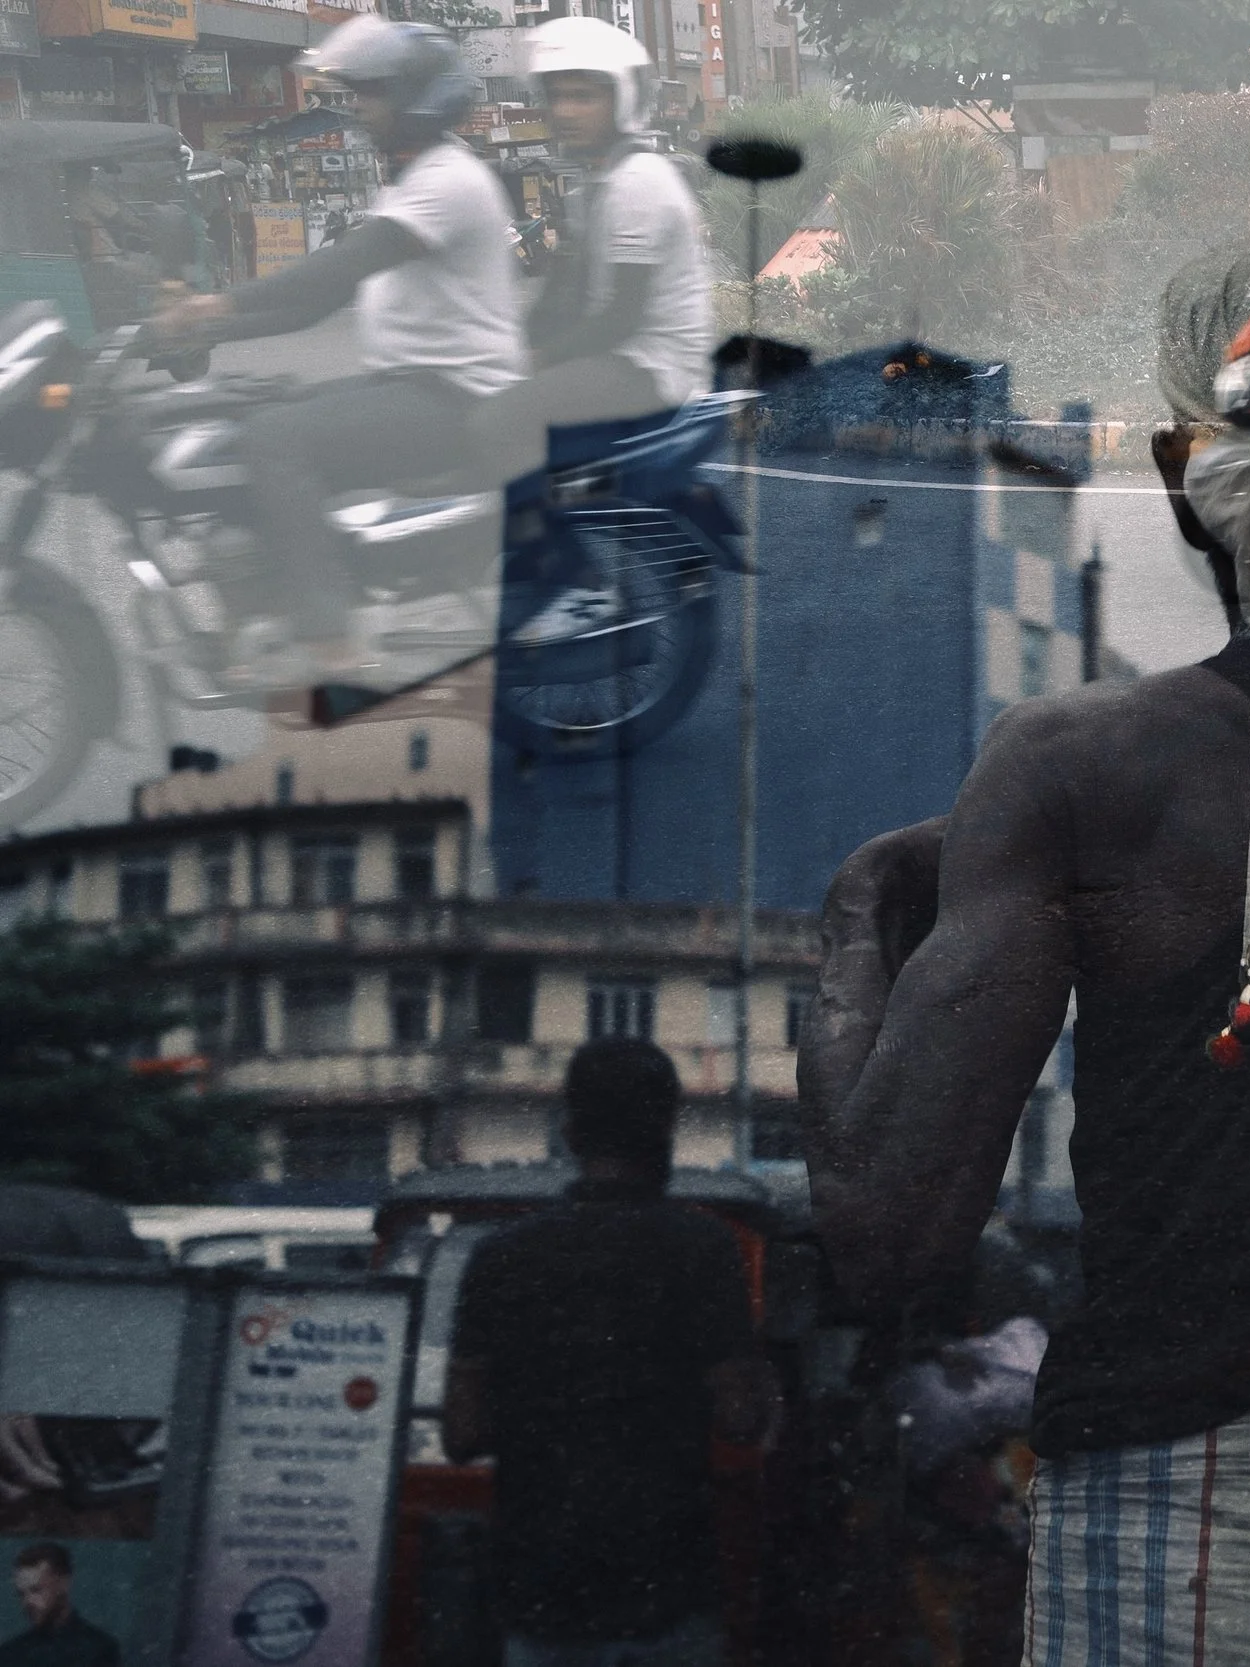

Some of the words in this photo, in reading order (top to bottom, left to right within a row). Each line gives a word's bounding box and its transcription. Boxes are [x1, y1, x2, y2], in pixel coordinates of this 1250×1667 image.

[616, 0, 631, 34] LS
[710, 3, 723, 61] IGA
[291, 1318, 386, 1345] Quick
